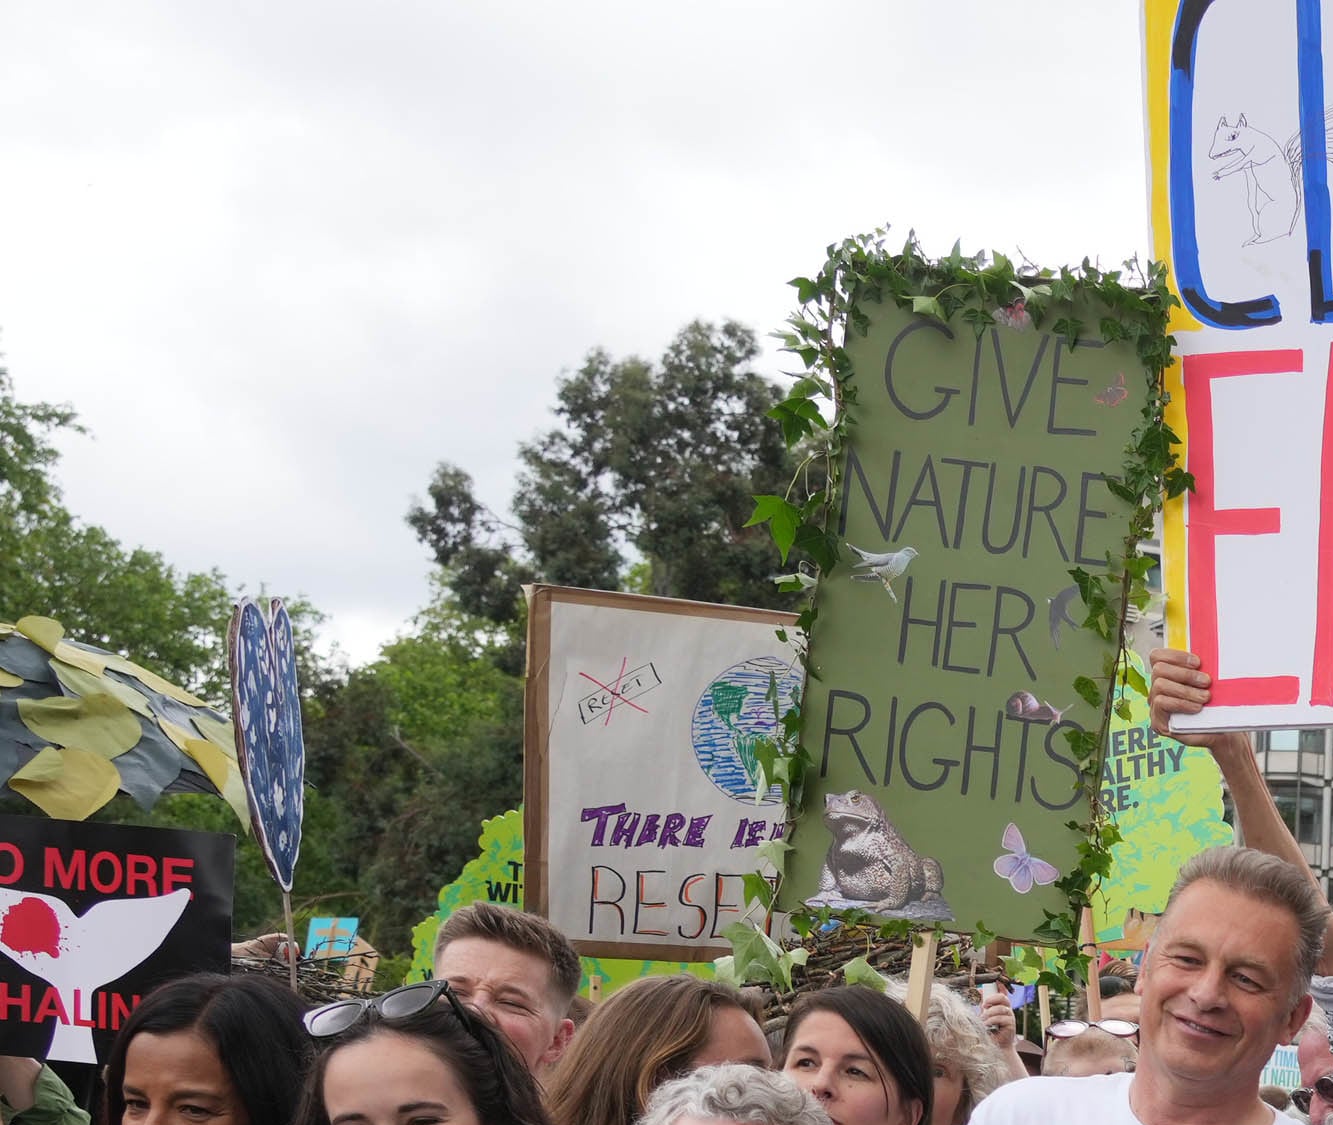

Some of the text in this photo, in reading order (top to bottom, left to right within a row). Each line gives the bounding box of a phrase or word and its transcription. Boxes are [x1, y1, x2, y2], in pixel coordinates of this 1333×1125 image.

[884, 319, 1104, 436] GIVE
[837, 447, 1122, 567] NATURE
[898, 576, 1037, 682] HER
[819, 689, 1087, 811] RIGHTS
[1100, 745, 1185, 786] ALTHY
[43, 846, 195, 901] MORE
[580, 803, 713, 849] THERE
